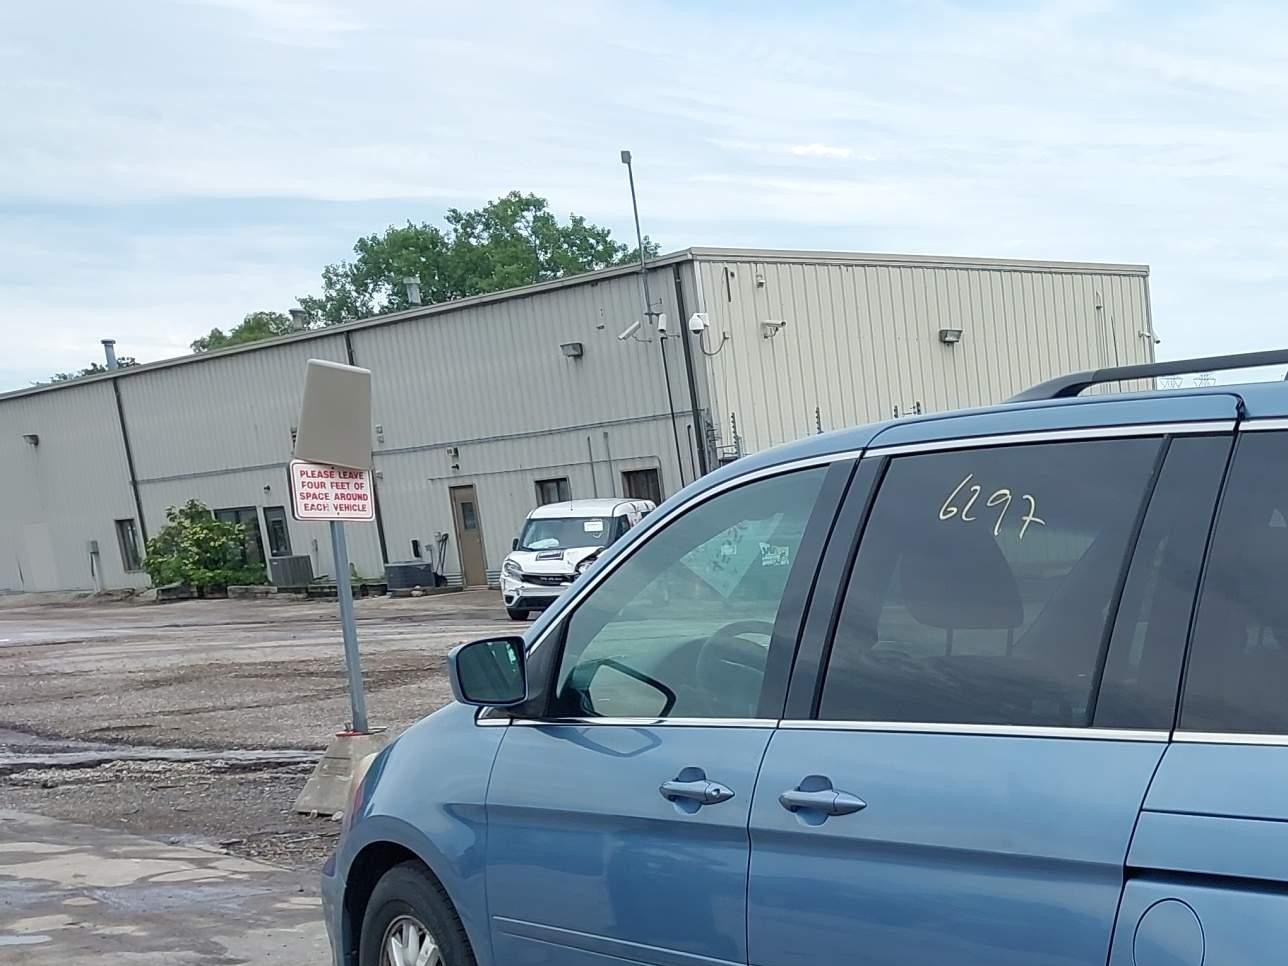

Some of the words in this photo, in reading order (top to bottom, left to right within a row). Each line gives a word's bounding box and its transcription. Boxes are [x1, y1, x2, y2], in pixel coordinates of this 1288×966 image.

[299, 470, 335, 479] PLEASE
[338, 470, 364, 480] LEAVE
[301, 481, 326, 489] FOUR
[330, 482, 350, 490] FEET
[353, 482, 365, 490] OF
[299, 492, 330, 501] SPACE
[334, 493, 368, 501] AROUND
[303, 503, 329, 512] EACH
[333, 504, 367, 512] VEHICLE
[939, 474, 1045, 539] 6297
